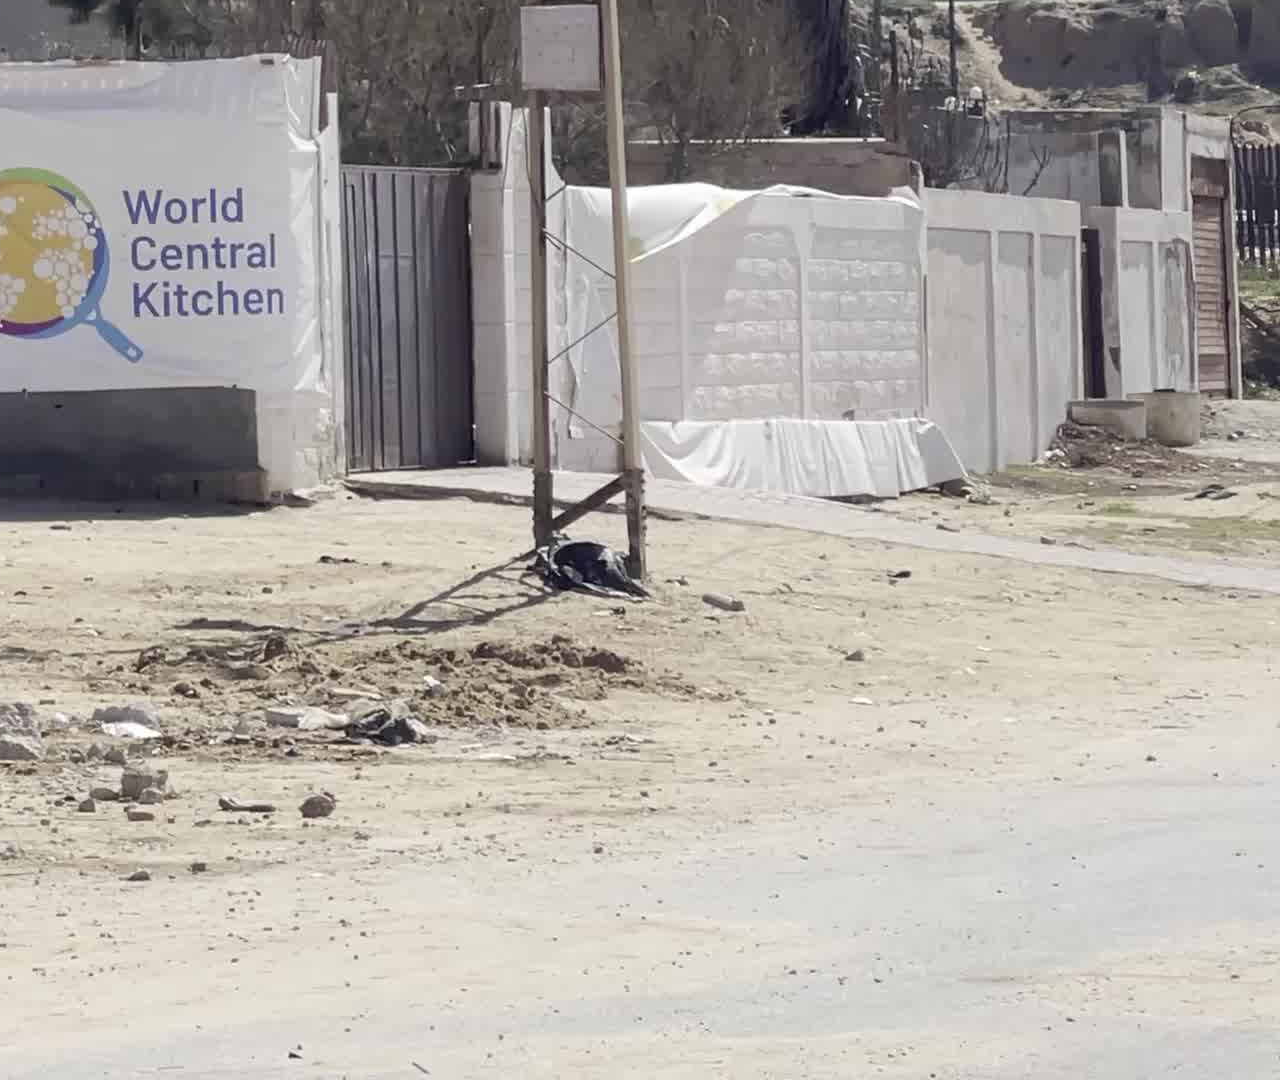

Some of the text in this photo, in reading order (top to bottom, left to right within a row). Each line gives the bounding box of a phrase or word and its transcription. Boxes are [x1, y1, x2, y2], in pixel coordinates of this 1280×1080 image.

[122, 187, 243, 225] World
[131, 233, 275, 271] Central
[133, 280, 283, 318] Kitchen
